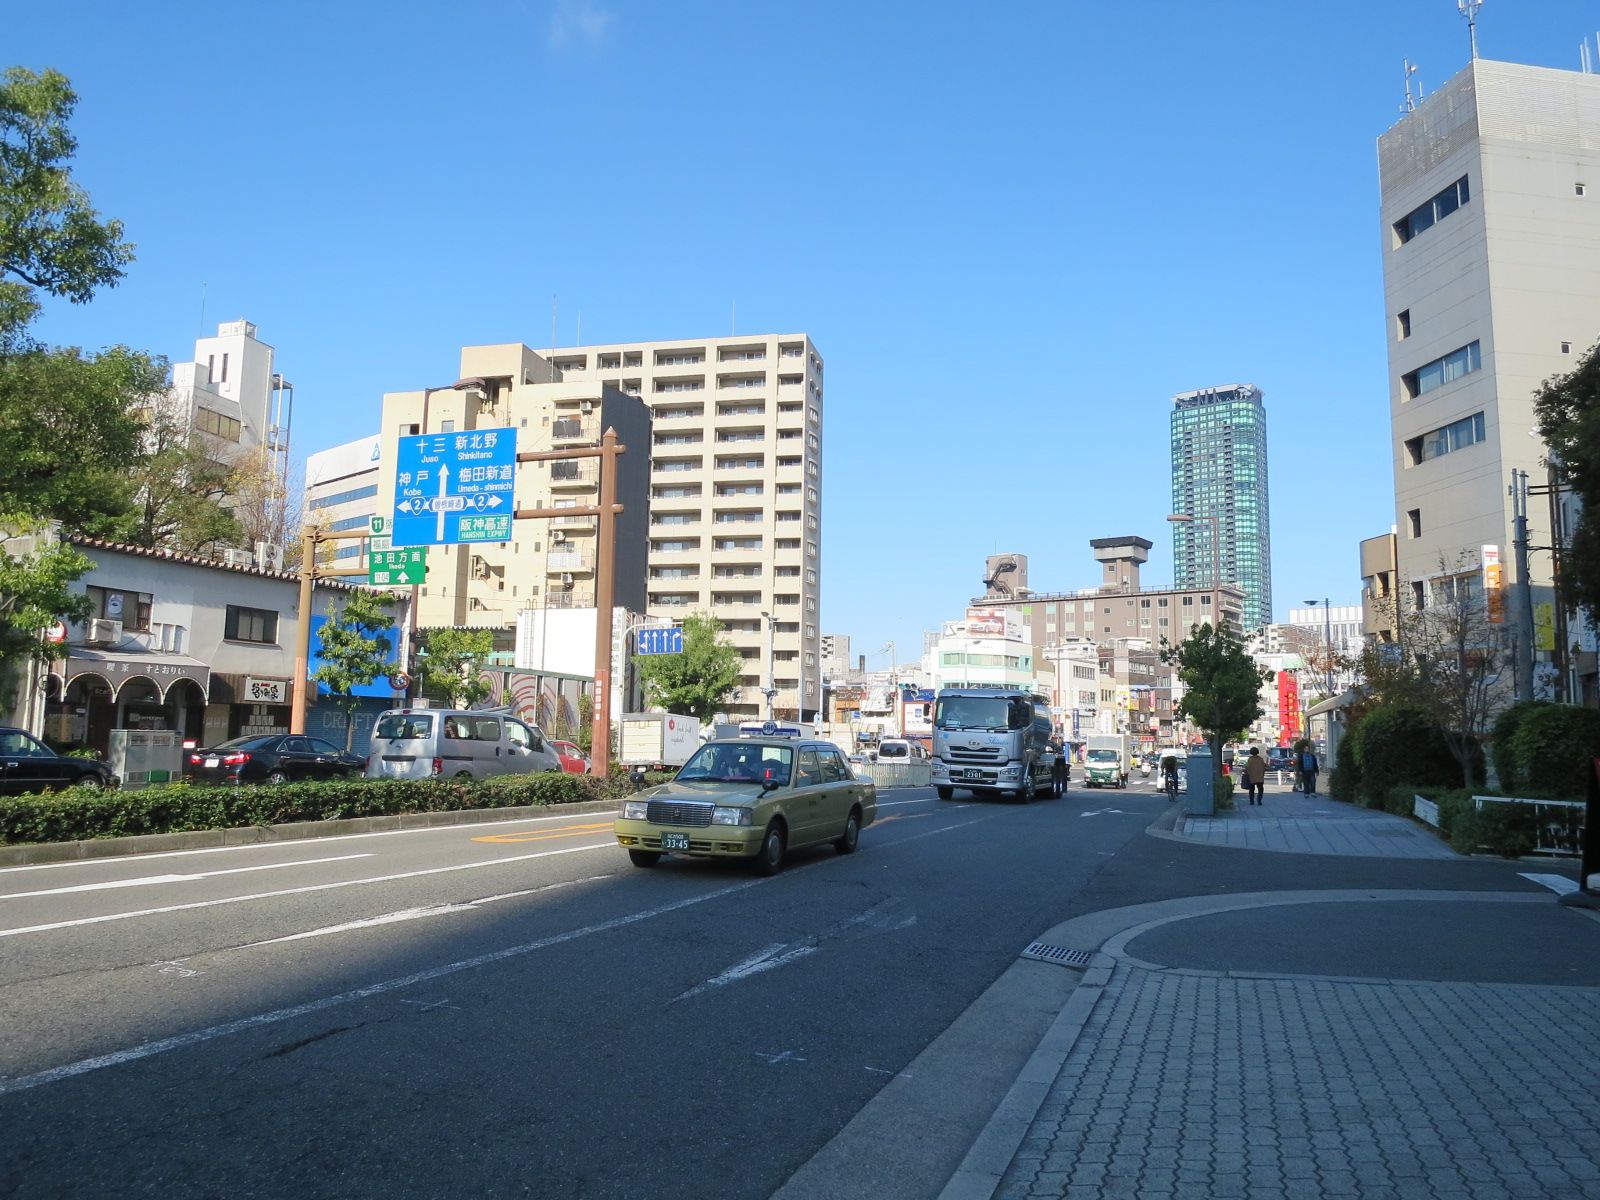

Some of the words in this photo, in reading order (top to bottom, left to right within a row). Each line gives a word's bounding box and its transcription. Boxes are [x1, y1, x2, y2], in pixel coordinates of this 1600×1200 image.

[416, 438, 446, 454] 十三
[455, 432, 497, 450] 新北野
[421, 455, 439, 463] Juso
[457, 451, 493, 461] Shinkitano
[399, 470, 429, 486] 神戸
[459, 464, 513, 483] 梅田新道
[403, 488, 422, 496] Kobe
[414, 500, 421, 510] 2
[477, 496, 485, 507] 2
[373, 519, 382, 530] 11
[460, 516, 509, 531] 阪神高速
[461, 530, 485, 539] HANSHIN
[487, 528, 507, 538] EXPWY
[374, 551, 421, 564] 池田方面
[106, 663, 130, 672] 喫茶
[666, 839, 688, 849] 33-45
